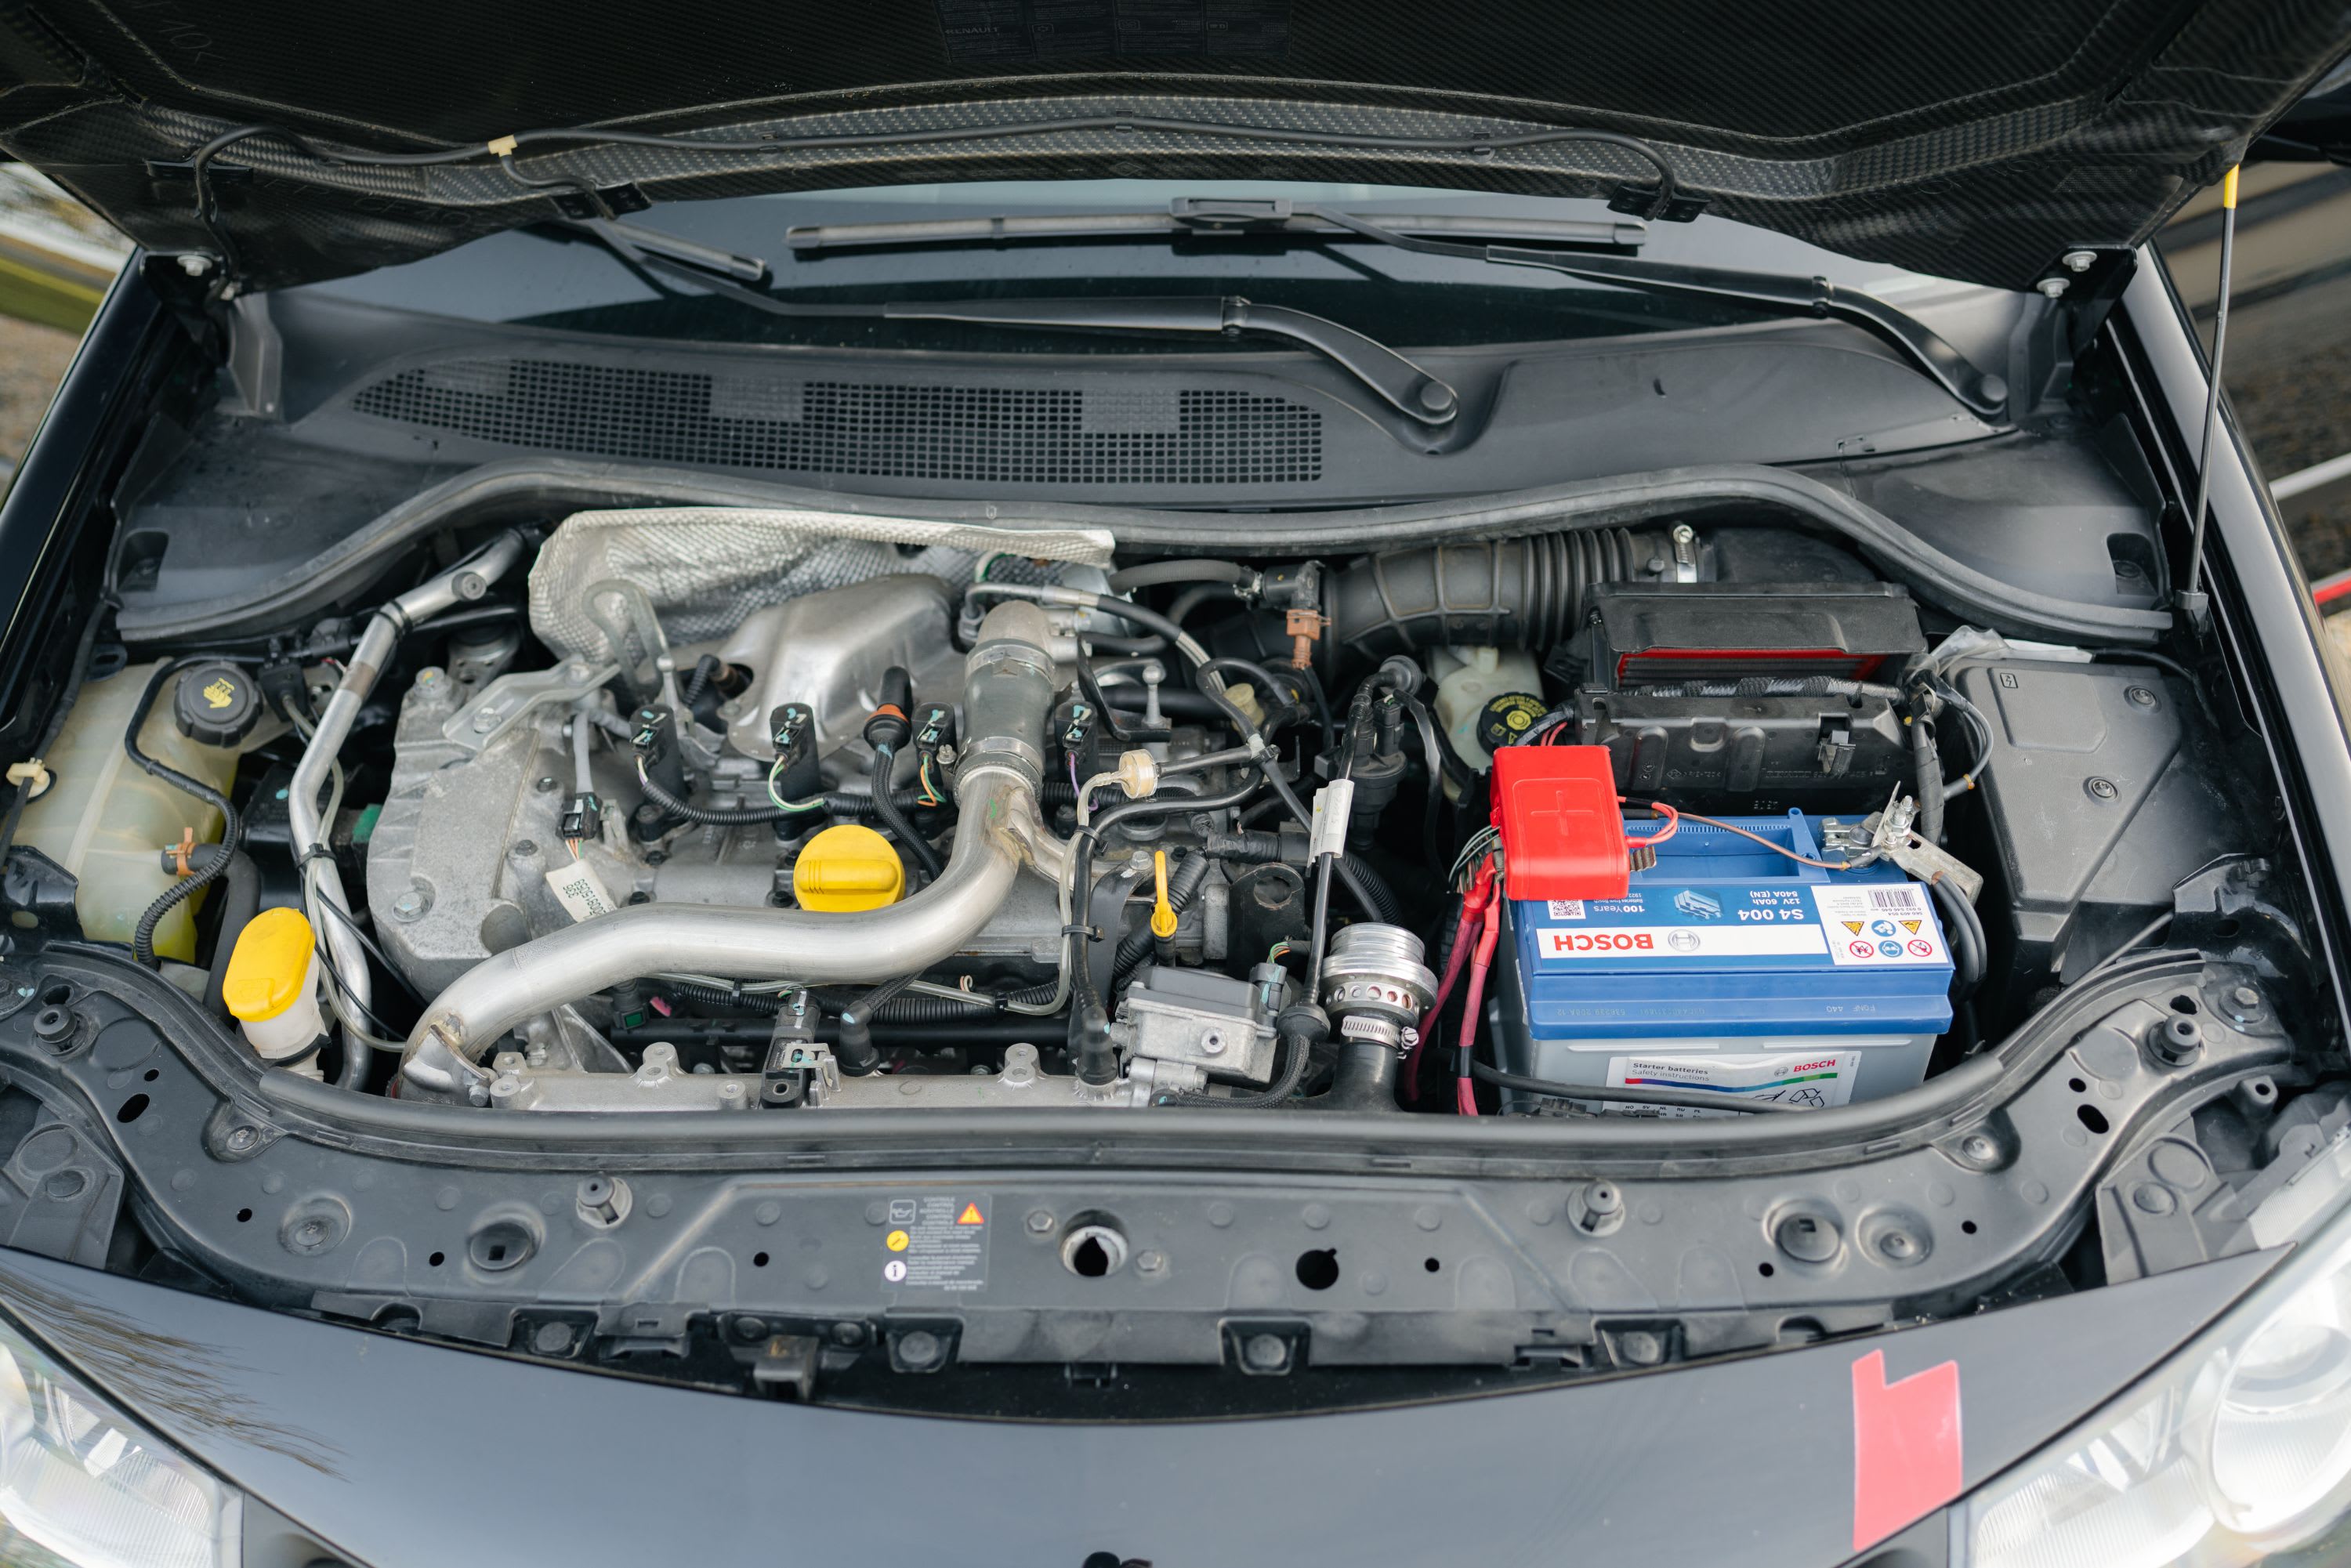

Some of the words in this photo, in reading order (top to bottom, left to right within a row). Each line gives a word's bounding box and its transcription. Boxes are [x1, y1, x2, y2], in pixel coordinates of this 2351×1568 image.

[1593, 904, 1623, 913] Years
[1622, 904, 1646, 913] 100
[1737, 909, 1774, 921] 004
[1778, 909, 1805, 920] S4
[1553, 933, 1654, 951] BOSCH
[1668, 1066, 1708, 1074] batteries
[1793, 1059, 1836, 1072] BOSCH
[1660, 1072, 1710, 1081] instructions
